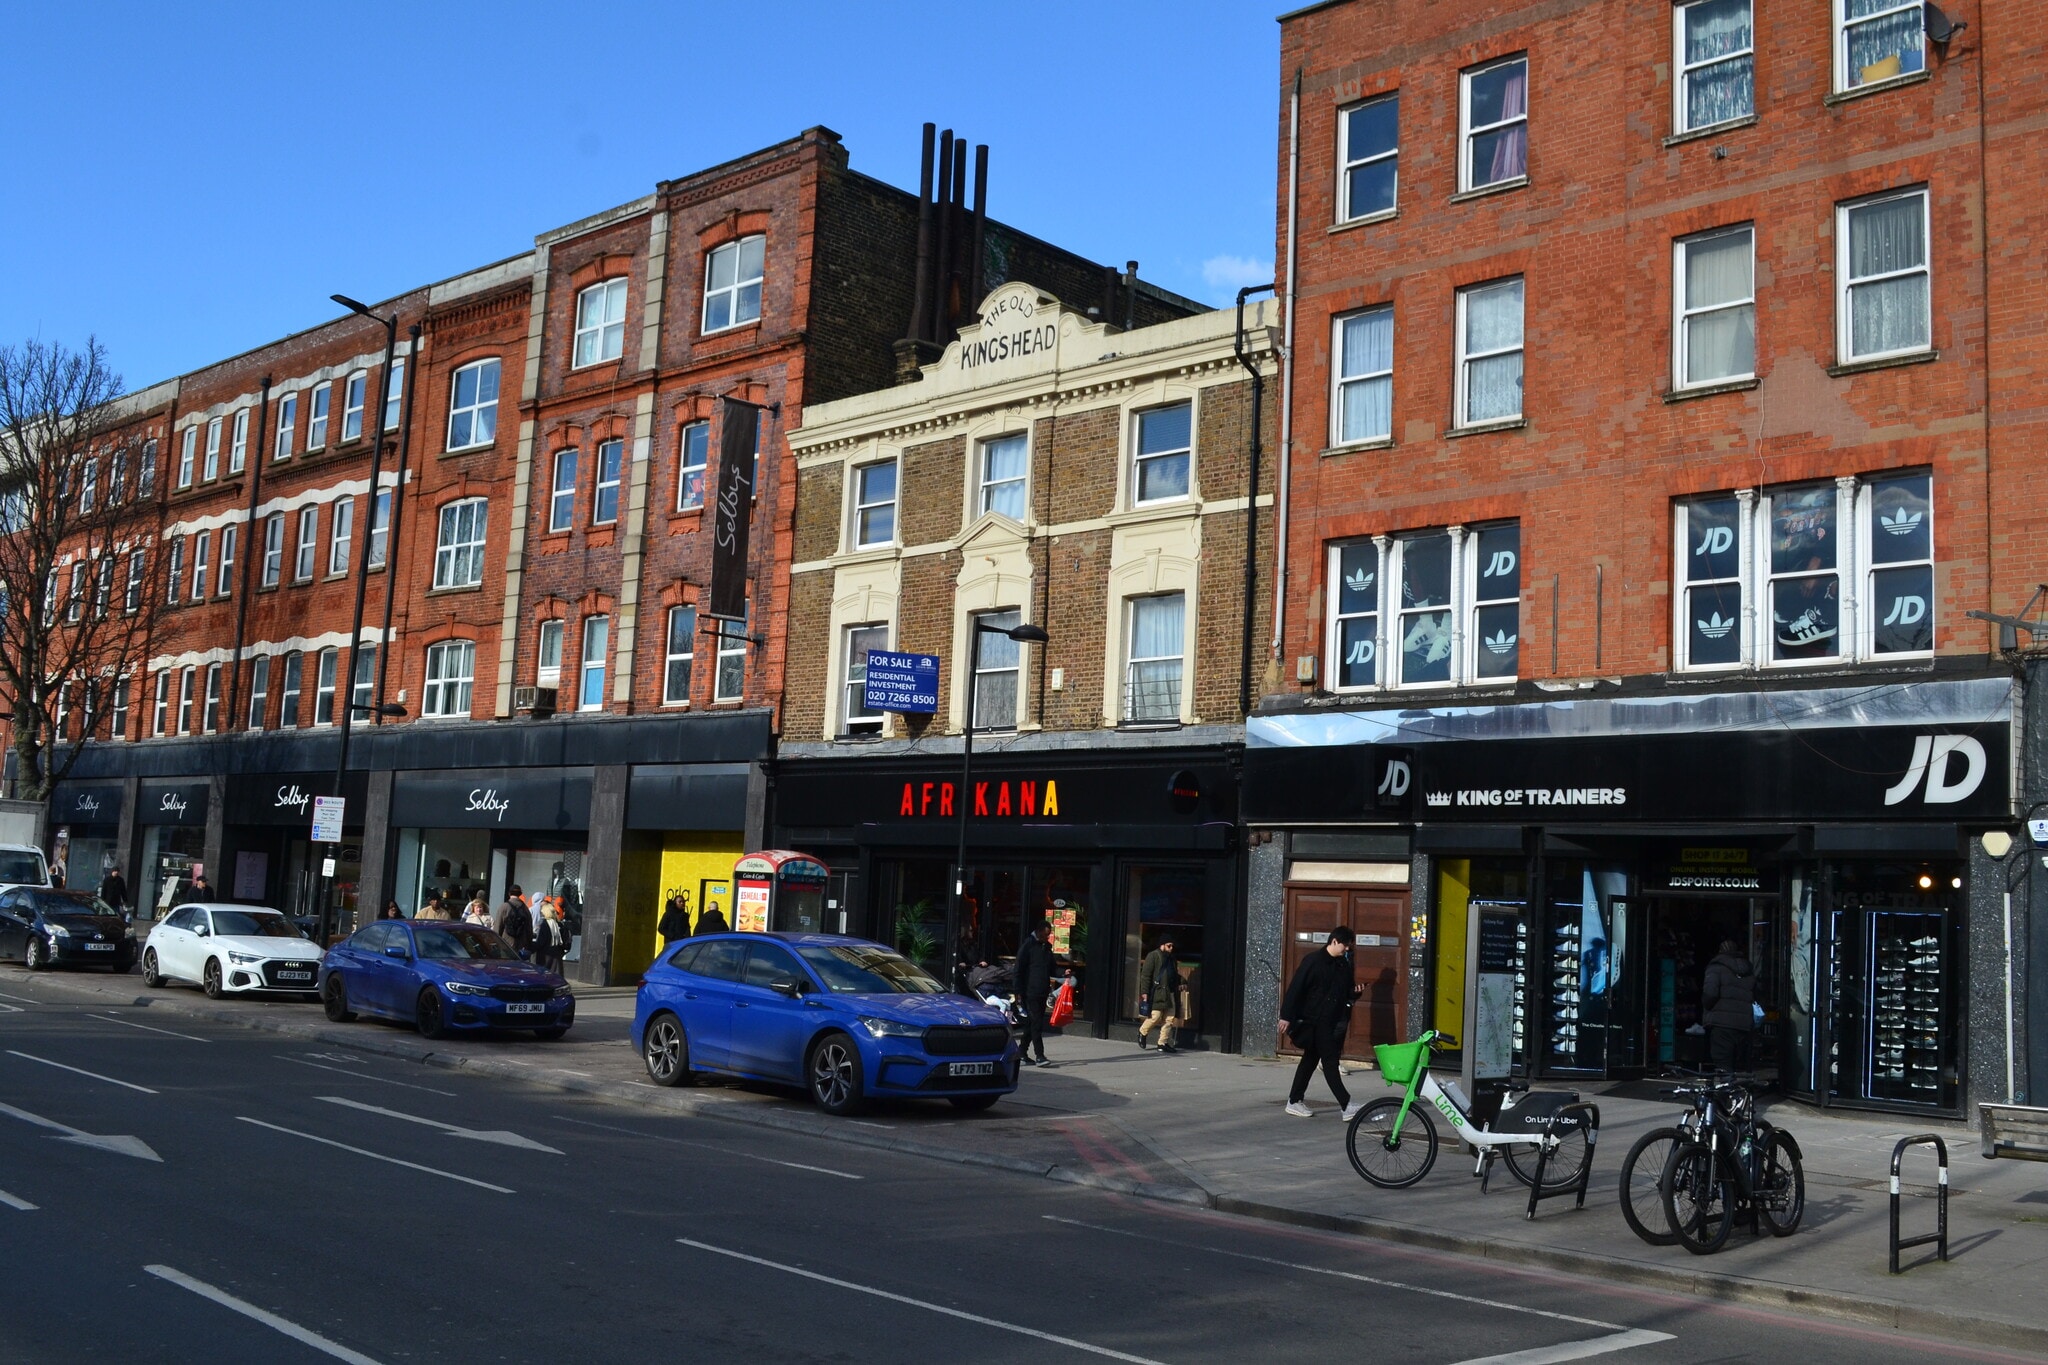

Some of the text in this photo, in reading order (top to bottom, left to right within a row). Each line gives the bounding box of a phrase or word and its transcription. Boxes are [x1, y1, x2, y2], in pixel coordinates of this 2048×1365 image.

[984, 295, 1034, 327] THE OLD
[716, 463, 751, 556] Selbys
[1695, 526, 1734, 556] JD
[1483, 550, 1516, 577] JD
[1883, 595, 1926, 625] JD
[869, 655, 888, 667] FOR
[890, 657, 912, 669] SALE
[1345, 639, 1375, 664] JD
[868, 680, 917, 691] INVESTMENT
[869, 671, 916, 682] RESIDENTIAL
[867, 700, 912, 709] estate-office.com
[868, 691, 935, 705] 020 7266 8500
[1377, 759, 1411, 797] JD
[1885, 735, 1987, 806] JD
[159, 792, 188, 819] Selbys
[274, 785, 310, 815] Selbys
[465, 789, 510, 822] Selbys
[900, 779, 1059, 817] AFRKANA
[1456, 786, 1627, 806] KING OF TRAINERS
[1684, 850, 1710, 860] SHOP
[1668, 876, 1760, 889] JDSPORTS.CO.UK
[509, 1004, 543, 1012] MF69 JMU
[954, 1064, 976, 1075] LF73
[1434, 1093, 1465, 1128] Lime
[1524, 1115, 1578, 1125] On Lim Uber
